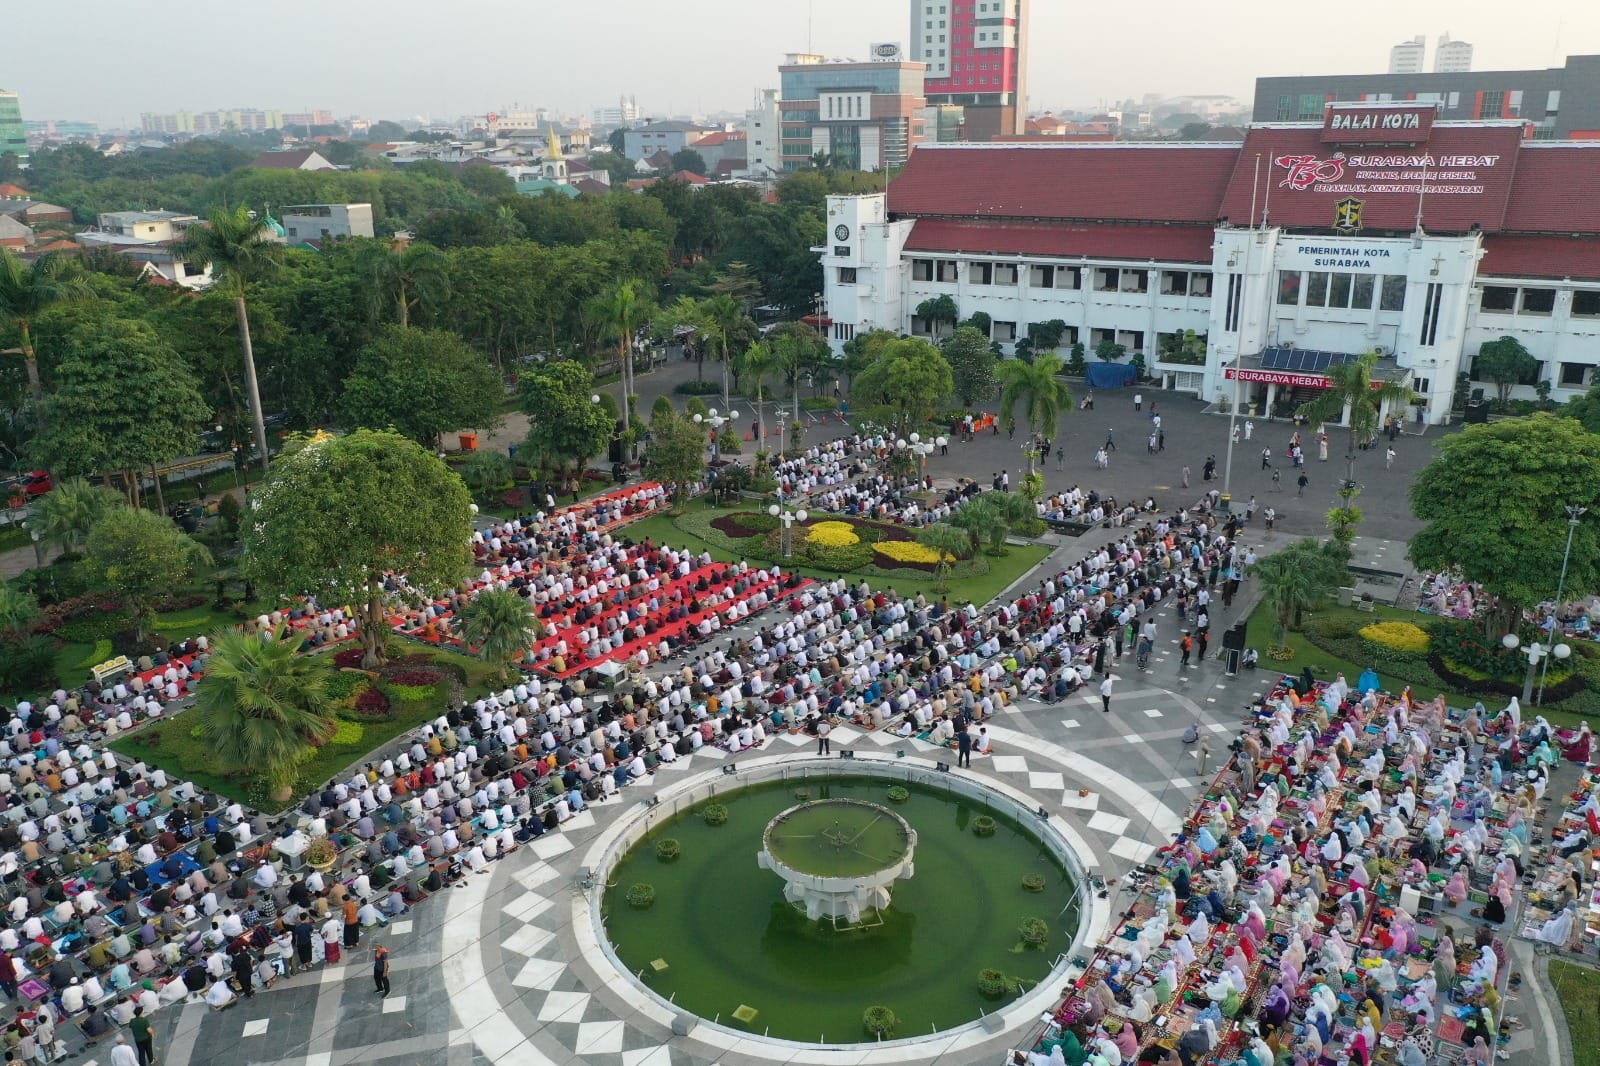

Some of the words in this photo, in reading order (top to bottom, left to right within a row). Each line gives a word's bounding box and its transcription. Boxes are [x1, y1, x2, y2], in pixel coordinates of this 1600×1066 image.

[1331, 114, 1378, 129] BALAI
[1382, 113, 1419, 129] KOTA
[1348, 155, 1435, 167] SURABAYA
[1439, 155, 1500, 167] HEBAT
[1438, 171, 1476, 180] EFISIEN,
[1421, 184, 1484, 194] TRANSPARAN
[1298, 246, 1360, 257] PEMERINTAH
[1364, 249, 1390, 257] KOTA
[1314, 258, 1371, 268] SURABAYA
[1238, 371, 1290, 384] SURABAYA
[1291, 376, 1325, 387] HEBAT
